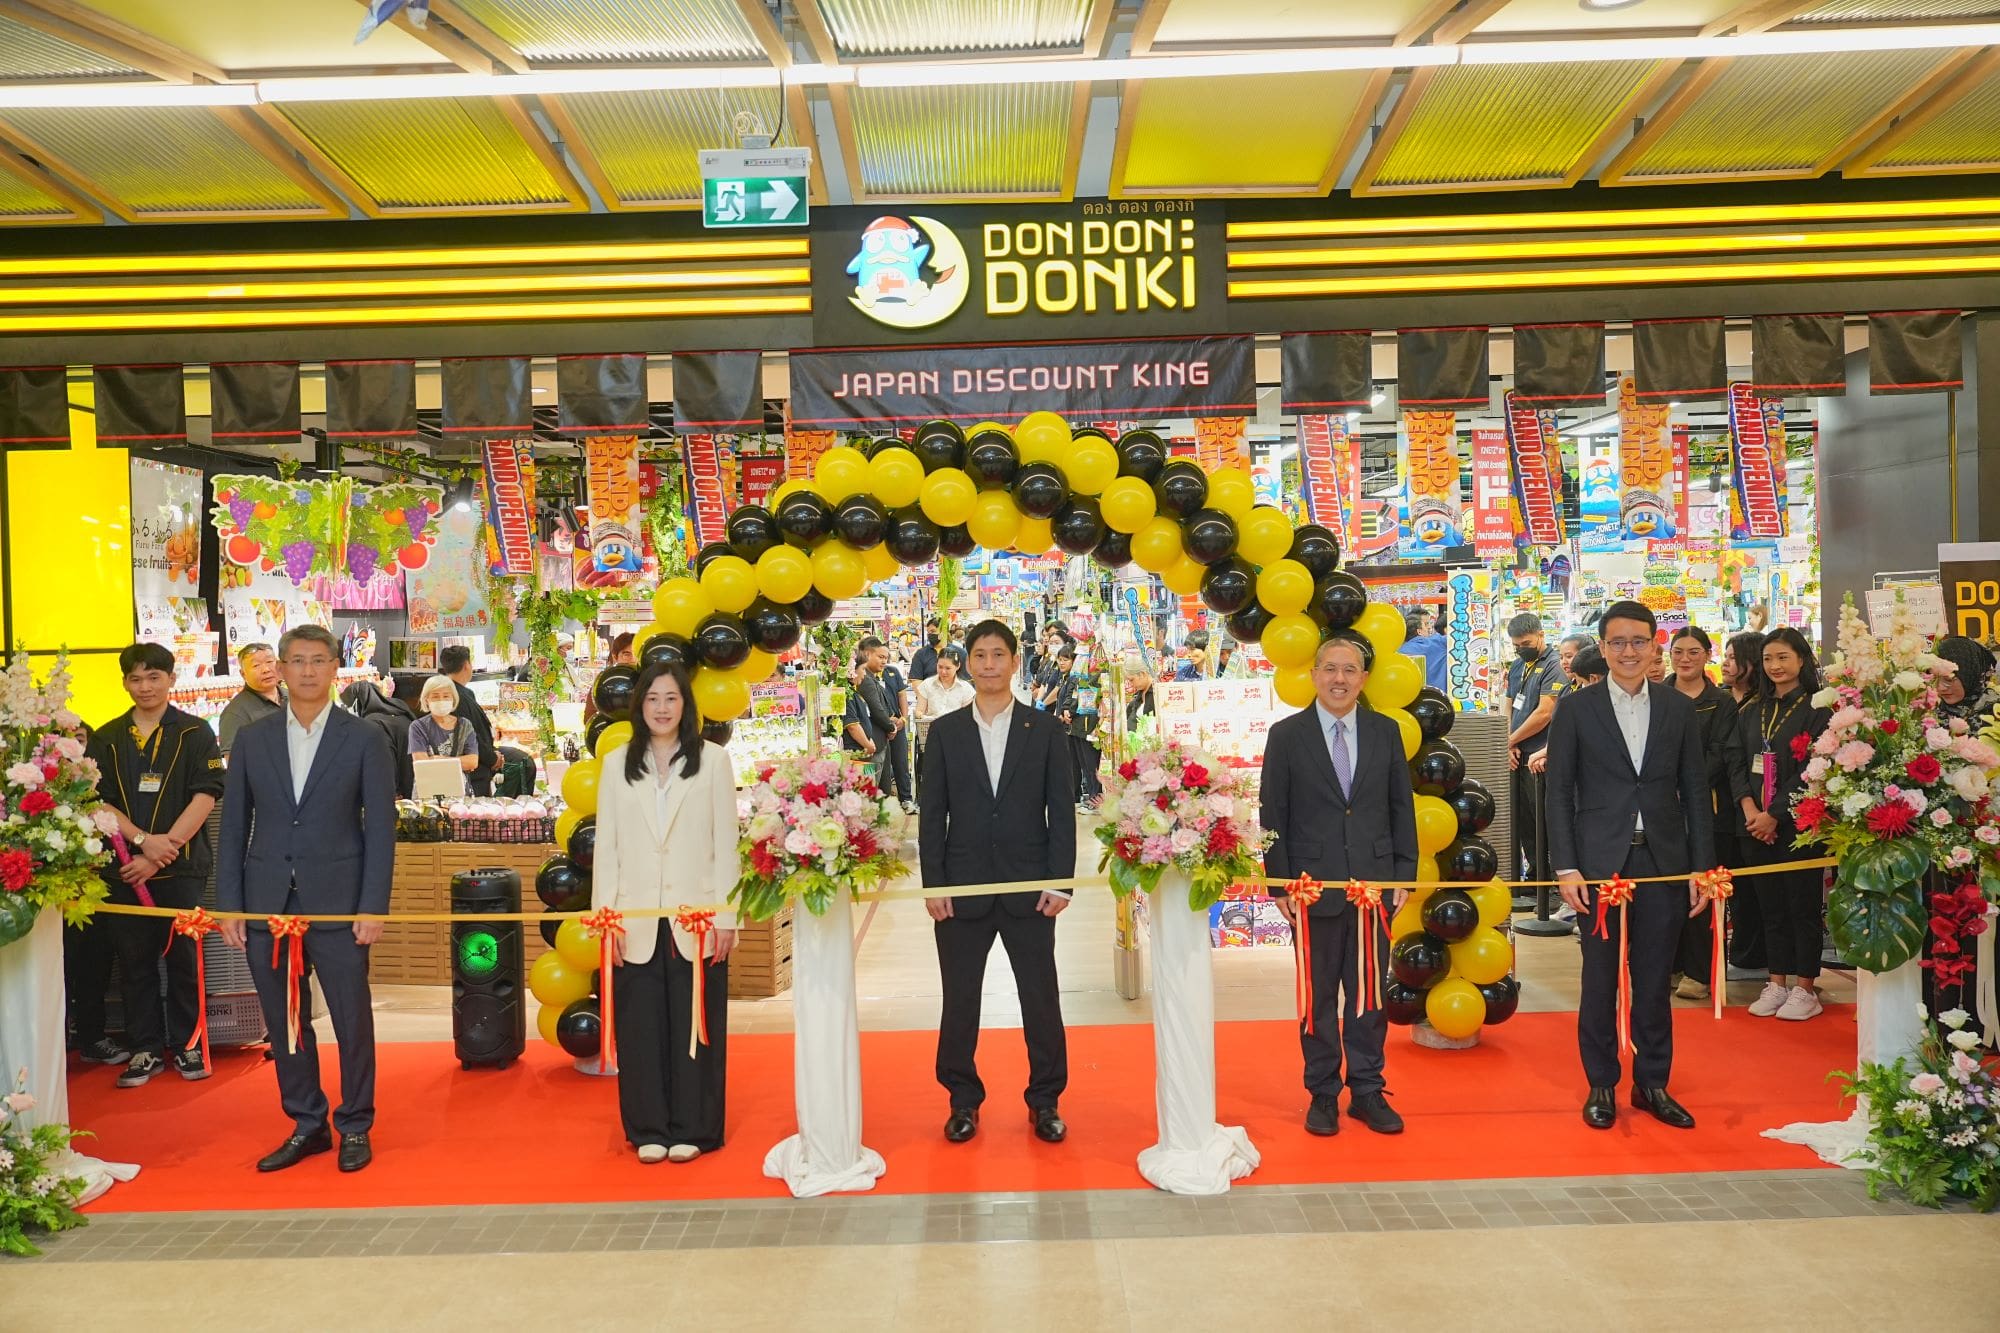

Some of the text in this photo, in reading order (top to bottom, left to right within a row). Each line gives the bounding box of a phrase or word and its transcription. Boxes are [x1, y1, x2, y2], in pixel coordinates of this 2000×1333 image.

[1083, 203, 1112, 215] ดอง
[1119, 202, 1148, 214] ดอง
[986, 255, 1195, 315] DONKI
[834, 360, 1210, 399] JAPAN DISCOUNT KING
[1508, 394, 1542, 453] RAND
[694, 479, 727, 547] OPENIN
[149, 554, 172, 570] fruits
[443, 615, 476, 629] 福島県
[1662, 612, 1688, 621] Snack
[1449, 573, 1473, 700] Recommended
